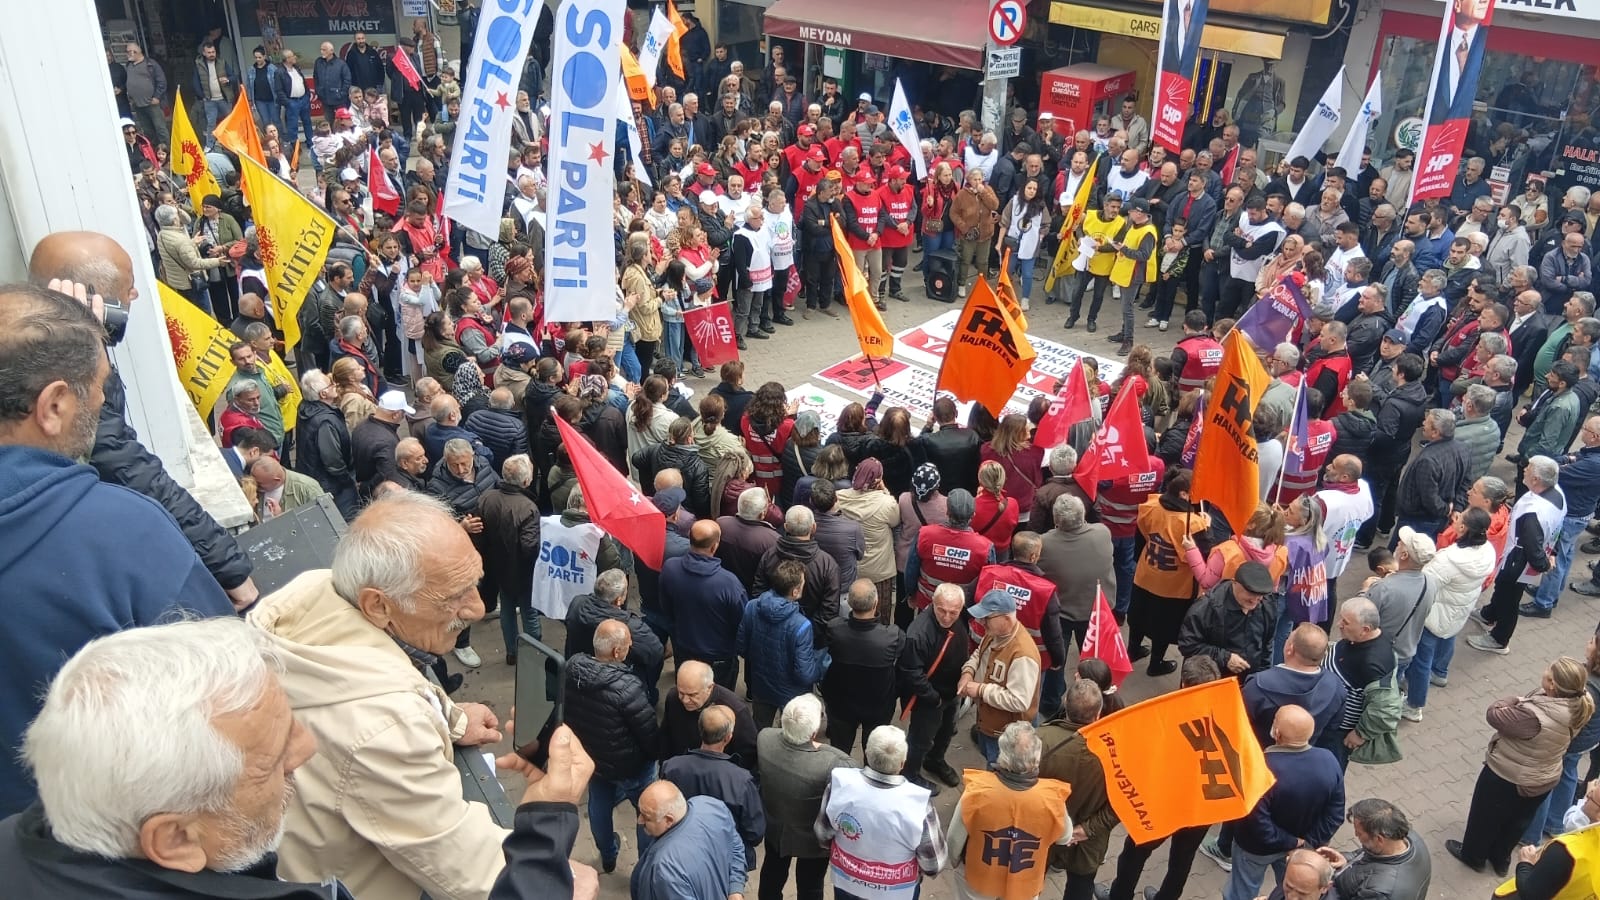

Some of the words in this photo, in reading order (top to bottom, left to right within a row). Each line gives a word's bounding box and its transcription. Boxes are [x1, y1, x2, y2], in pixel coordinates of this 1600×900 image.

[328, 20, 380, 32] MARKET
[1130, 19, 1160, 37] ÇARŞI
[800, 27, 851, 46] MEYDAN
[561, 3, 611, 147] SOL
[1162, 104, 1182, 126] CHP
[1563, 145, 1597, 163] HALK
[553, 160, 588, 289] PARTİ
[716, 316, 733, 344] CHP
[1140, 475, 1156, 483] CHP
[540, 540, 584, 573] SOL
[946, 548, 969, 559] CHP
[548, 566, 585, 585] PARTİ
[1006, 586, 1030, 598] CHP
